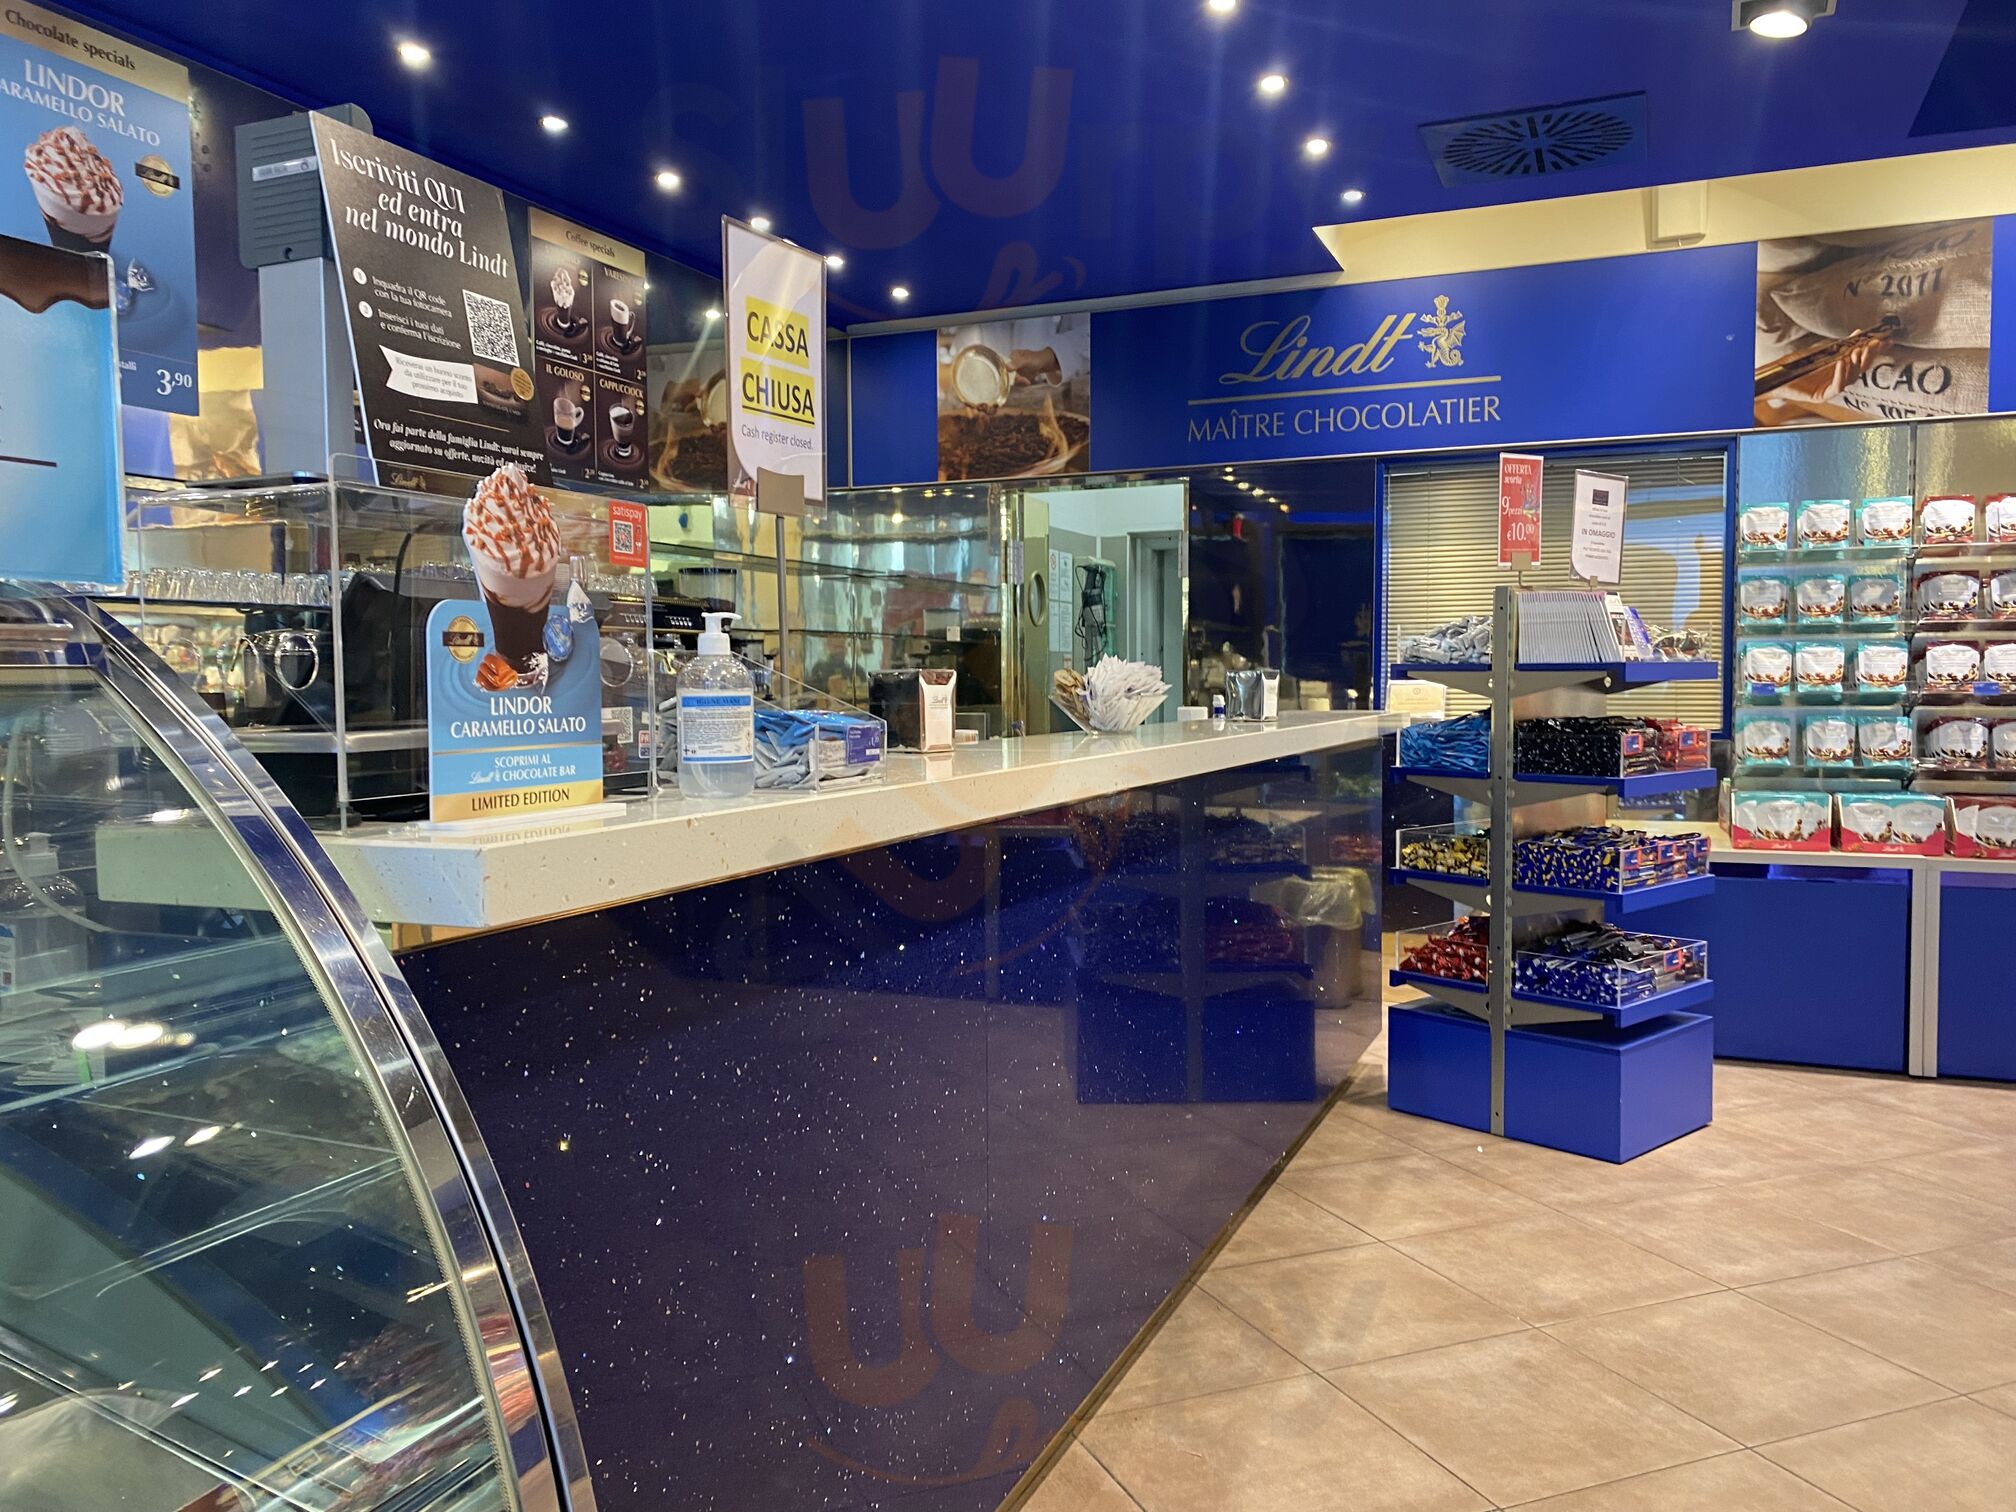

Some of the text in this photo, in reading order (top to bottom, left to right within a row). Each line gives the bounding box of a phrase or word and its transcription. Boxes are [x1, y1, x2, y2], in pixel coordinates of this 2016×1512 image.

[5, 9, 137, 71] Chocolate specials
[24, 59, 125, 117] LINDOR
[0, 78, 161, 147] ARAMELLO SALATO
[330, 138, 465, 214] Iscriviti QUI
[378, 192, 462, 238] ed entra
[346, 206, 508, 278] nel mondo Lindt
[589, 240, 615, 258] specials
[374, 289, 390, 299] con
[414, 289, 427, 301] QR
[747, 311, 810, 358] CASSA
[1219, 313, 1417, 385] Lindt
[545, 363, 553, 374] IL
[553, 365, 585, 382] GOLOSO
[742, 372, 815, 418] CHIUSA
[1188, 395, 1501, 443] MAÎTRE CHOCOLATIER
[391, 421, 404, 434] fai
[405, 426, 427, 438] parte
[427, 428, 447, 442] della
[741, 424, 814, 450] Cash register closed.
[433, 447, 443, 457] su
[1504, 463, 1532, 476] OFFERTA
[612, 505, 642, 521] satispay
[1581, 528, 1616, 539] IN OMAGGIO
[490, 696, 553, 716] LINDOR
[451, 716, 586, 738] CARAMELLO SALATO
[494, 754, 551, 769] SCOPRIMI AL
[502, 766, 557, 782] CHOCOLATE
[559, 763, 576, 776] BAR
[471, 788, 570, 812] LIMITED EDITION
